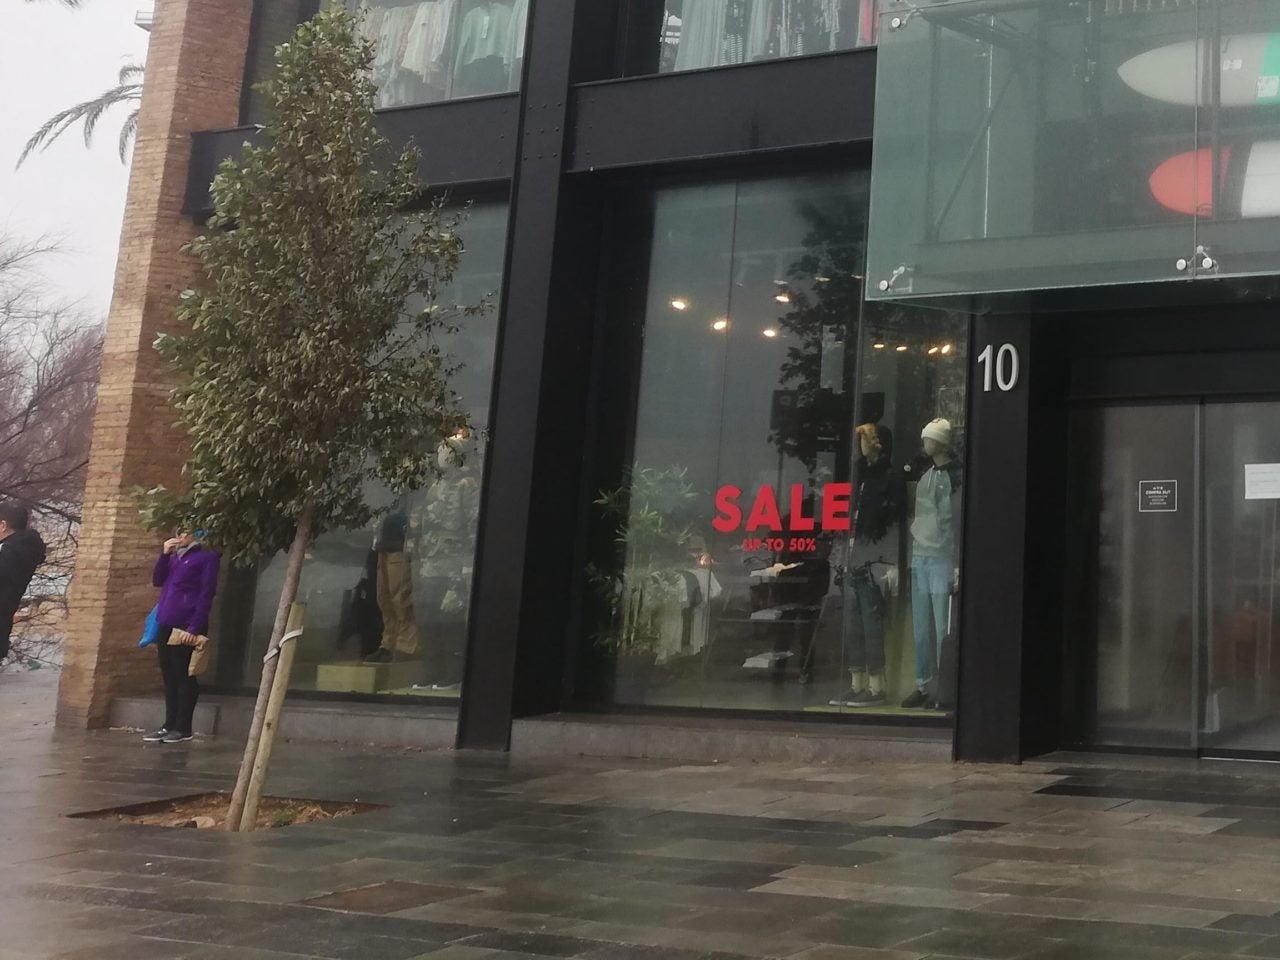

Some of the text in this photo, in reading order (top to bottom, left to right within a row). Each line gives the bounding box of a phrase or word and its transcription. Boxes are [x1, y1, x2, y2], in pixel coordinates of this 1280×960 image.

[977, 343, 1020, 392] 10
[711, 482, 853, 532] SALE
[743, 538, 816, 552] UP TO 50%
